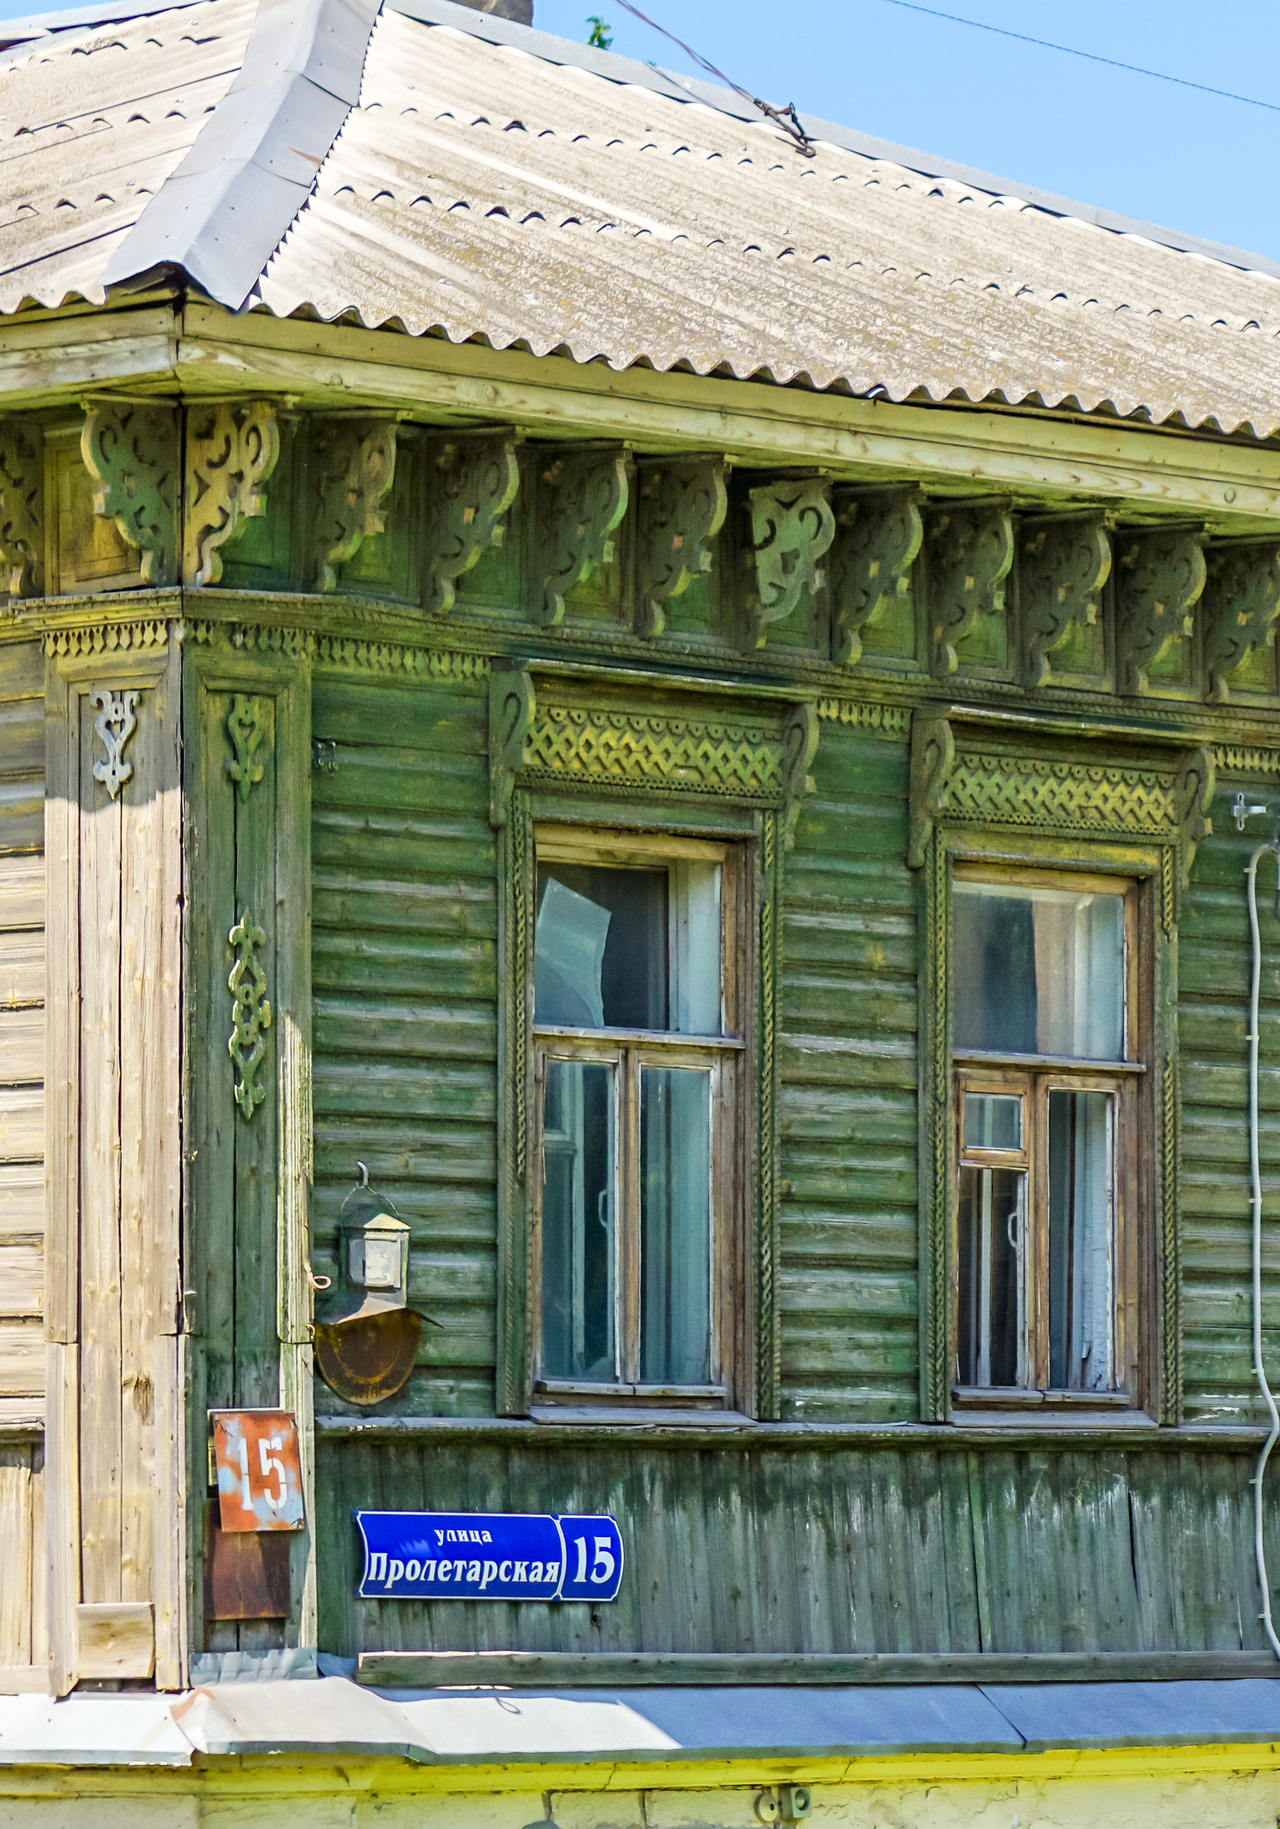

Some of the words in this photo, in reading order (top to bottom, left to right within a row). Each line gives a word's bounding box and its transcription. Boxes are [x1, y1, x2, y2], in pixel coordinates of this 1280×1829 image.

[237, 1436, 288, 1511] 15
[433, 1529, 493, 1546] улица
[367, 1552, 561, 1590] Пролетарская
[573, 1536, 616, 1584] 15
